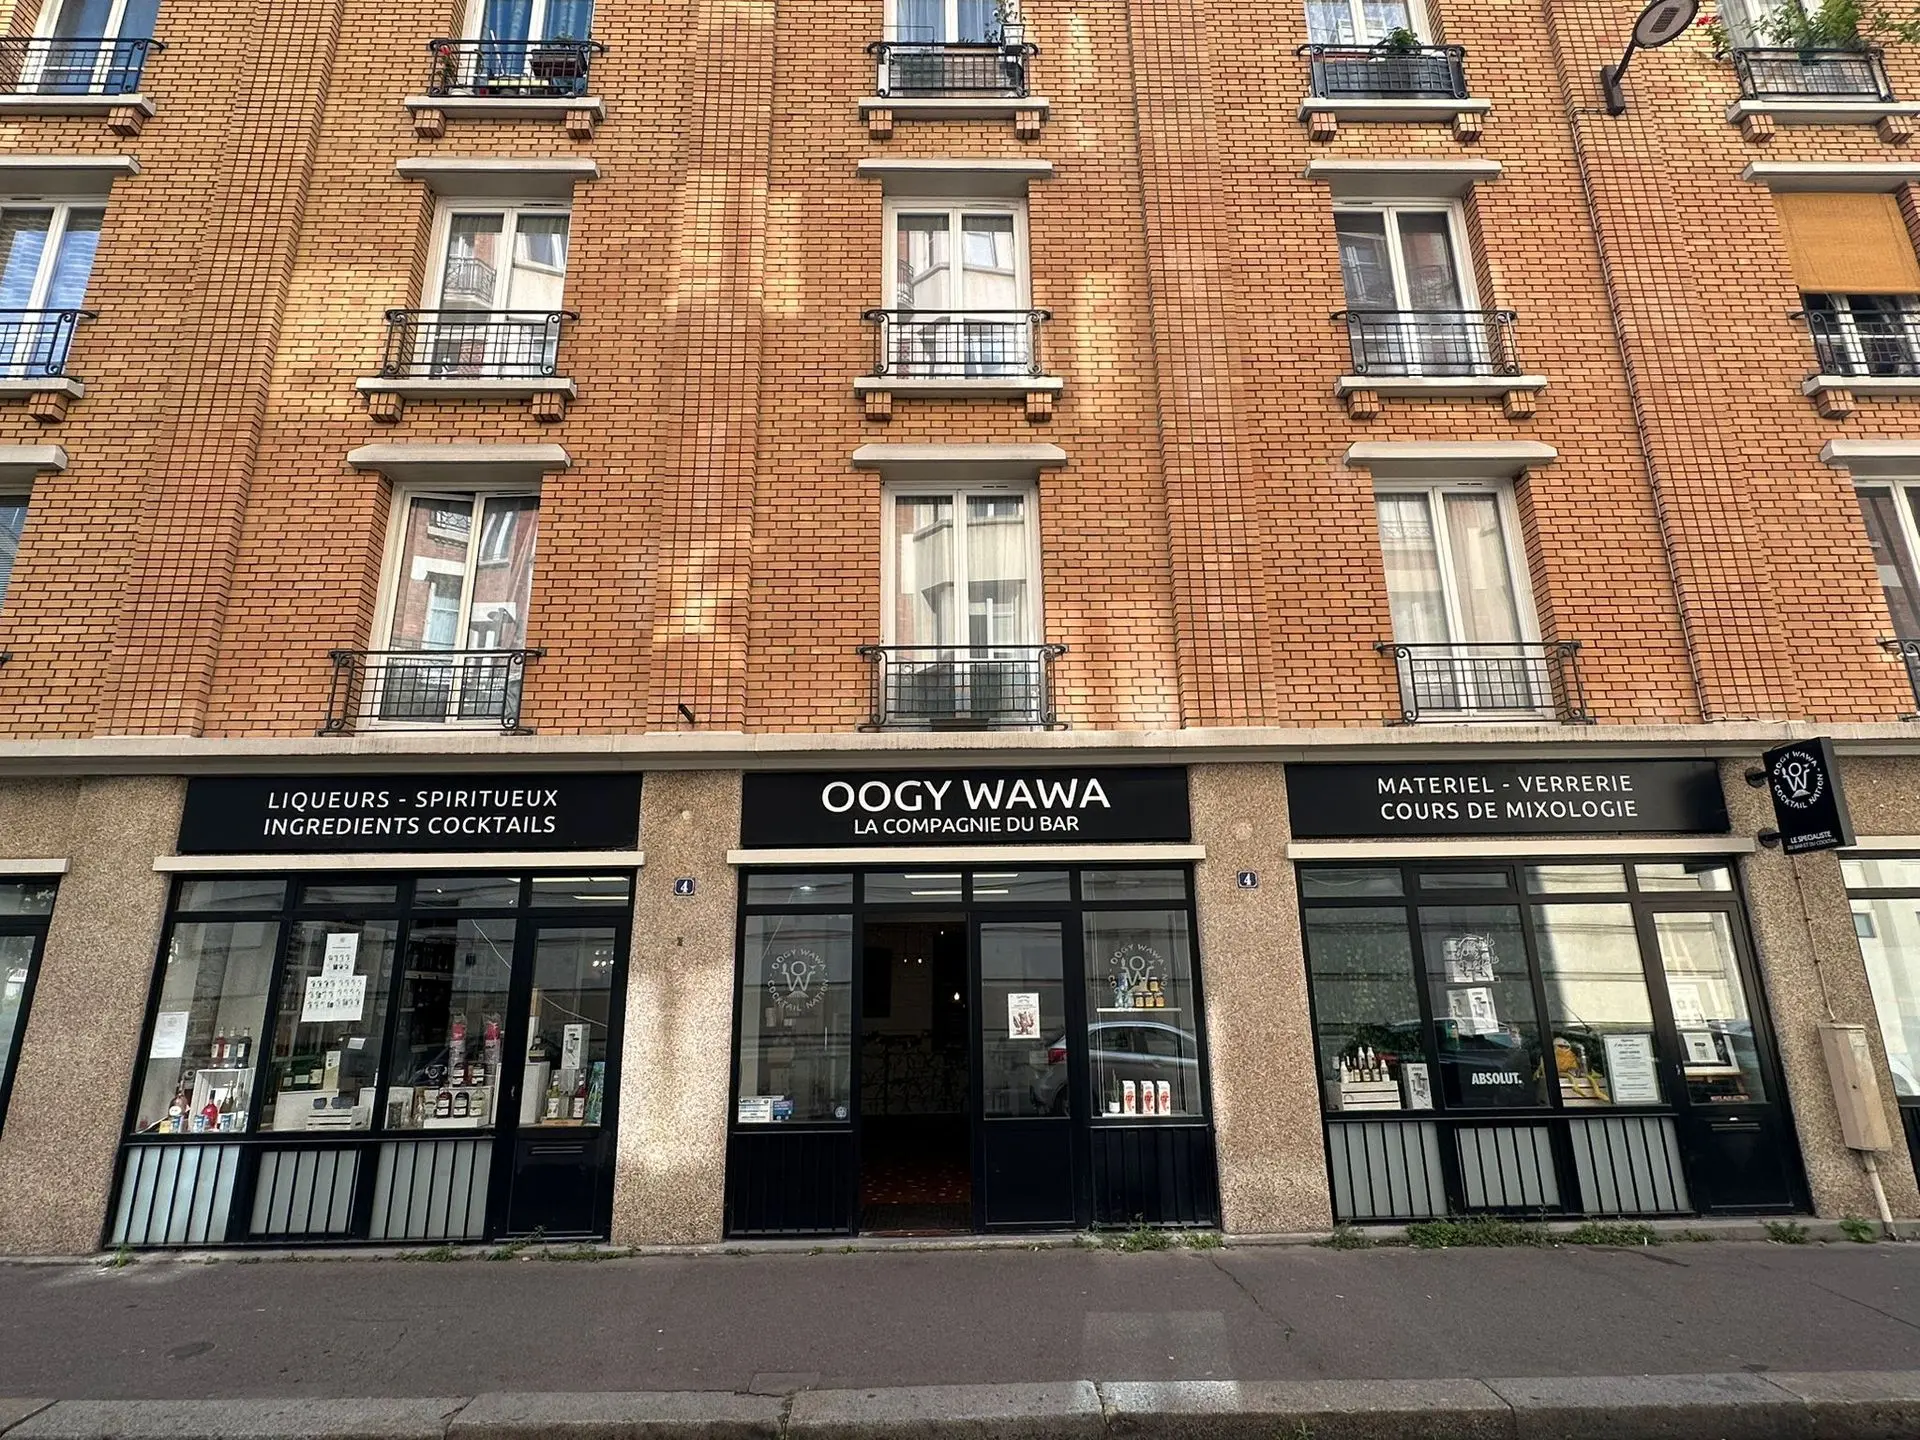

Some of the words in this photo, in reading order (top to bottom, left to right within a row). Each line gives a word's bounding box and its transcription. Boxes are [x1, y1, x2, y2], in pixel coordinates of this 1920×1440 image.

[1773, 752, 1790, 775] OOGY
[1792, 750, 1817, 767] WAWA
[821, 780, 952, 813] OOGY
[962, 778, 1111, 810] WAWA
[1377, 776, 1495, 795] MATERIEL
[1517, 775, 1634, 793] VERRERIE
[1774, 784, 1808, 809] COCKTAIL
[1808, 773, 1824, 805] NATION
[268, 791, 390, 813] LIQUEURS
[415, 789, 558, 808] SPIRITUEUX
[1381, 802, 1460, 820] COURS
[1467, 801, 1498, 819] DE
[1506, 800, 1639, 819] MIXOLOGIE
[263, 816, 420, 836] INGREDIENTS
[428, 815, 556, 835] COCKTAILS
[854, 818, 879, 835] LA
[883, 816, 1002, 835] COMPAGNIE
[1006, 816, 1034, 832] DU
[1039, 815, 1080, 832] BAR
[680, 880, 689, 893] 4
[1243, 873, 1252, 885] 4
[771, 949, 797, 970] OOGY
[800, 948, 826, 970] WAWA
[1110, 944, 1134, 965] OOGY
[1137, 943, 1164, 965] WAWA
[767, 980, 802, 1012] COCKTAIL
[805, 979, 829, 1009] NATION
[1471, 1072, 1523, 1085] ABSOLUT.
